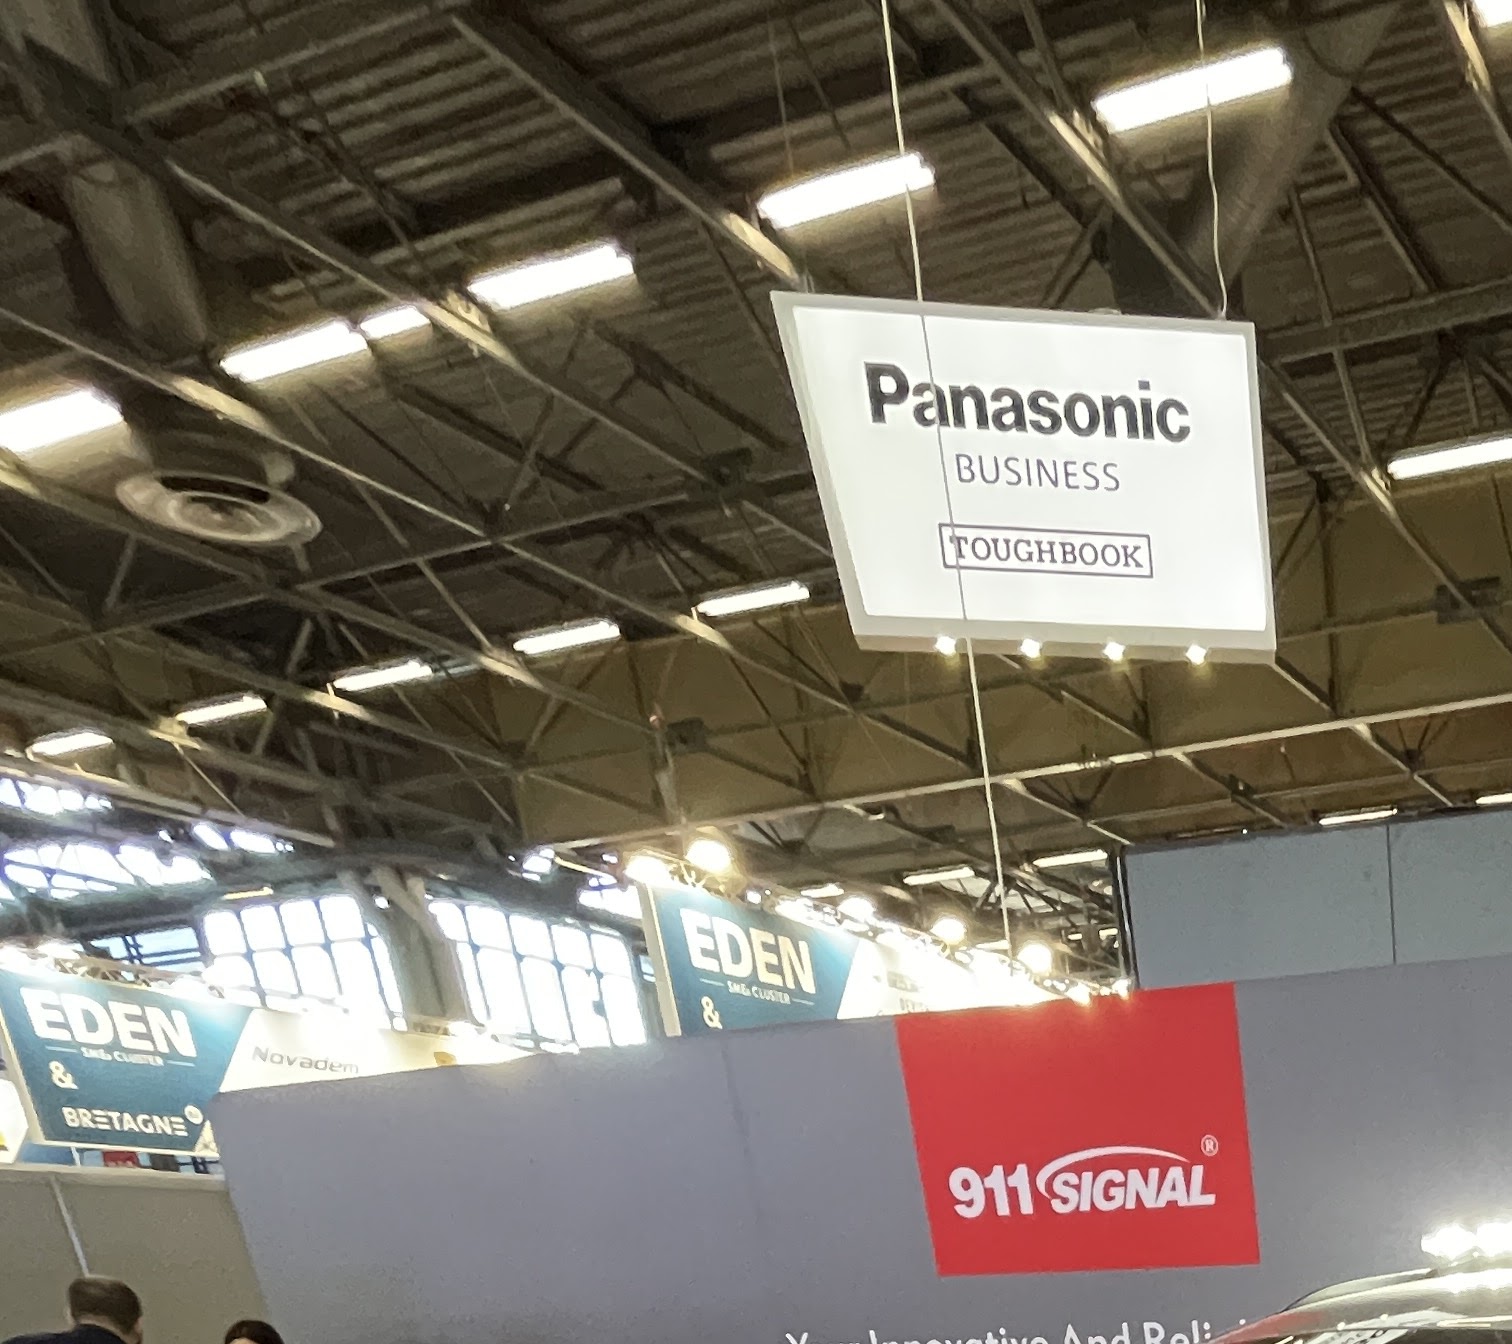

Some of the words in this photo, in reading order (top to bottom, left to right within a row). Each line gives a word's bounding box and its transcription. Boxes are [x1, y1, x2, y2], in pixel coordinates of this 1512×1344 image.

[864, 361, 1191, 443] Panasonic
[955, 453, 1121, 492] BUSINESS
[949, 535, 1144, 569] TOUGHBOOK
[679, 907, 816, 994] EDEN
[20, 987, 197, 1058] EDEN
[251, 1045, 359, 1074] Novadem
[61, 1105, 190, 1138] BRETAGNE
[948, 1163, 1034, 1219] 911
[1049, 1164, 1217, 1214] SIGNAL
